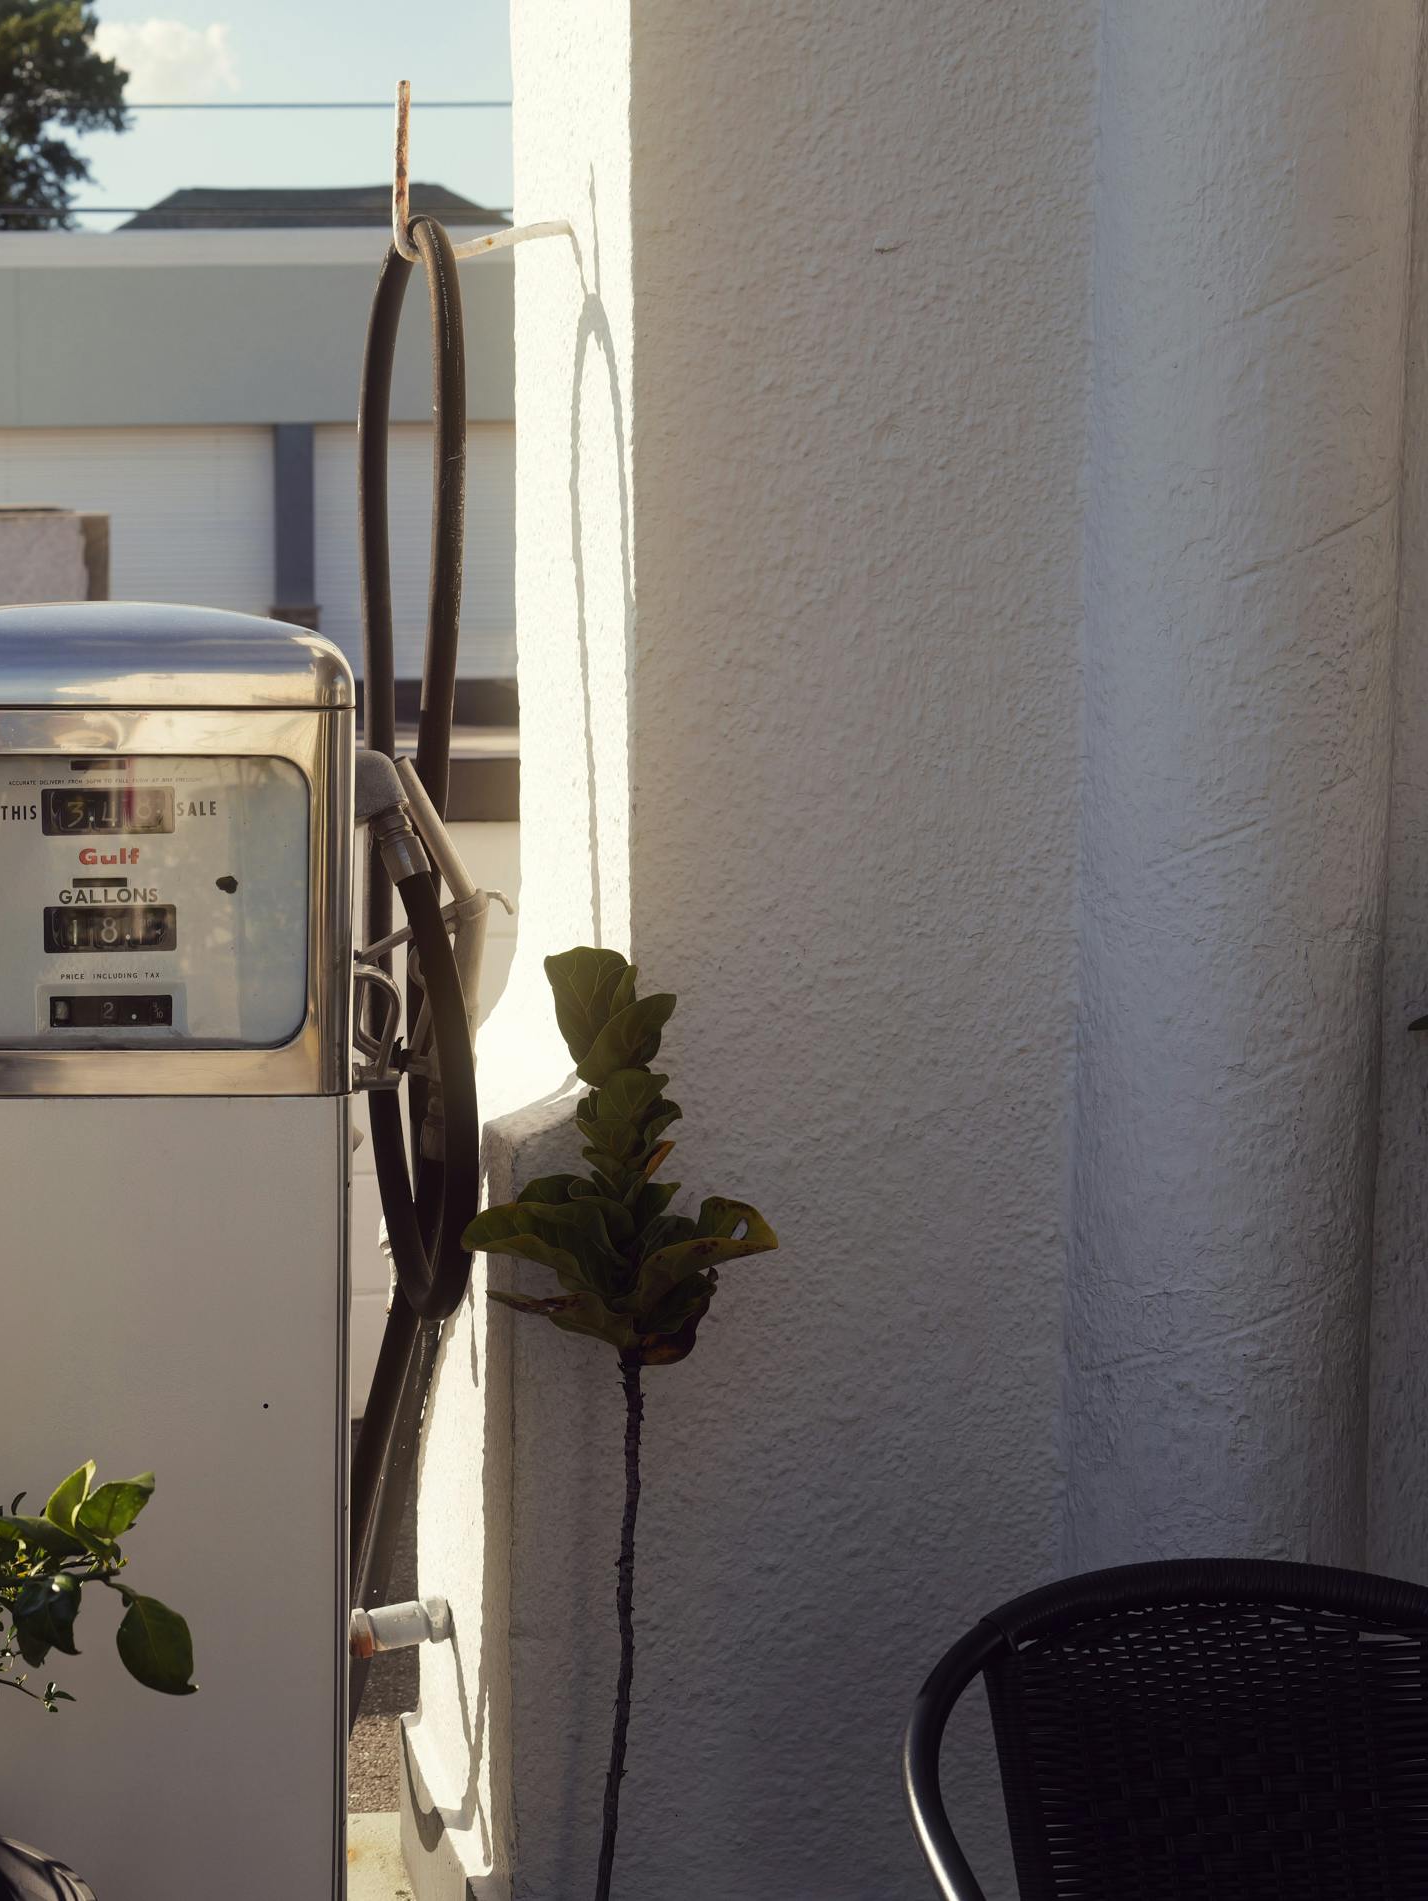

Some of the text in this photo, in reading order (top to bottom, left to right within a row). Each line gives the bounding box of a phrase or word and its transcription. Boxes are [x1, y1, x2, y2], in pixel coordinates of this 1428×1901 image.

[39, 778, 65, 786] DELIVERY
[0, 800, 217, 821] THIS SALE
[78, 847, 140, 865] Gulf
[58, 888, 159, 905] GALLONS
[92, 972, 138, 980] INCLUDING
[144, 971, 161, 979] TAX
